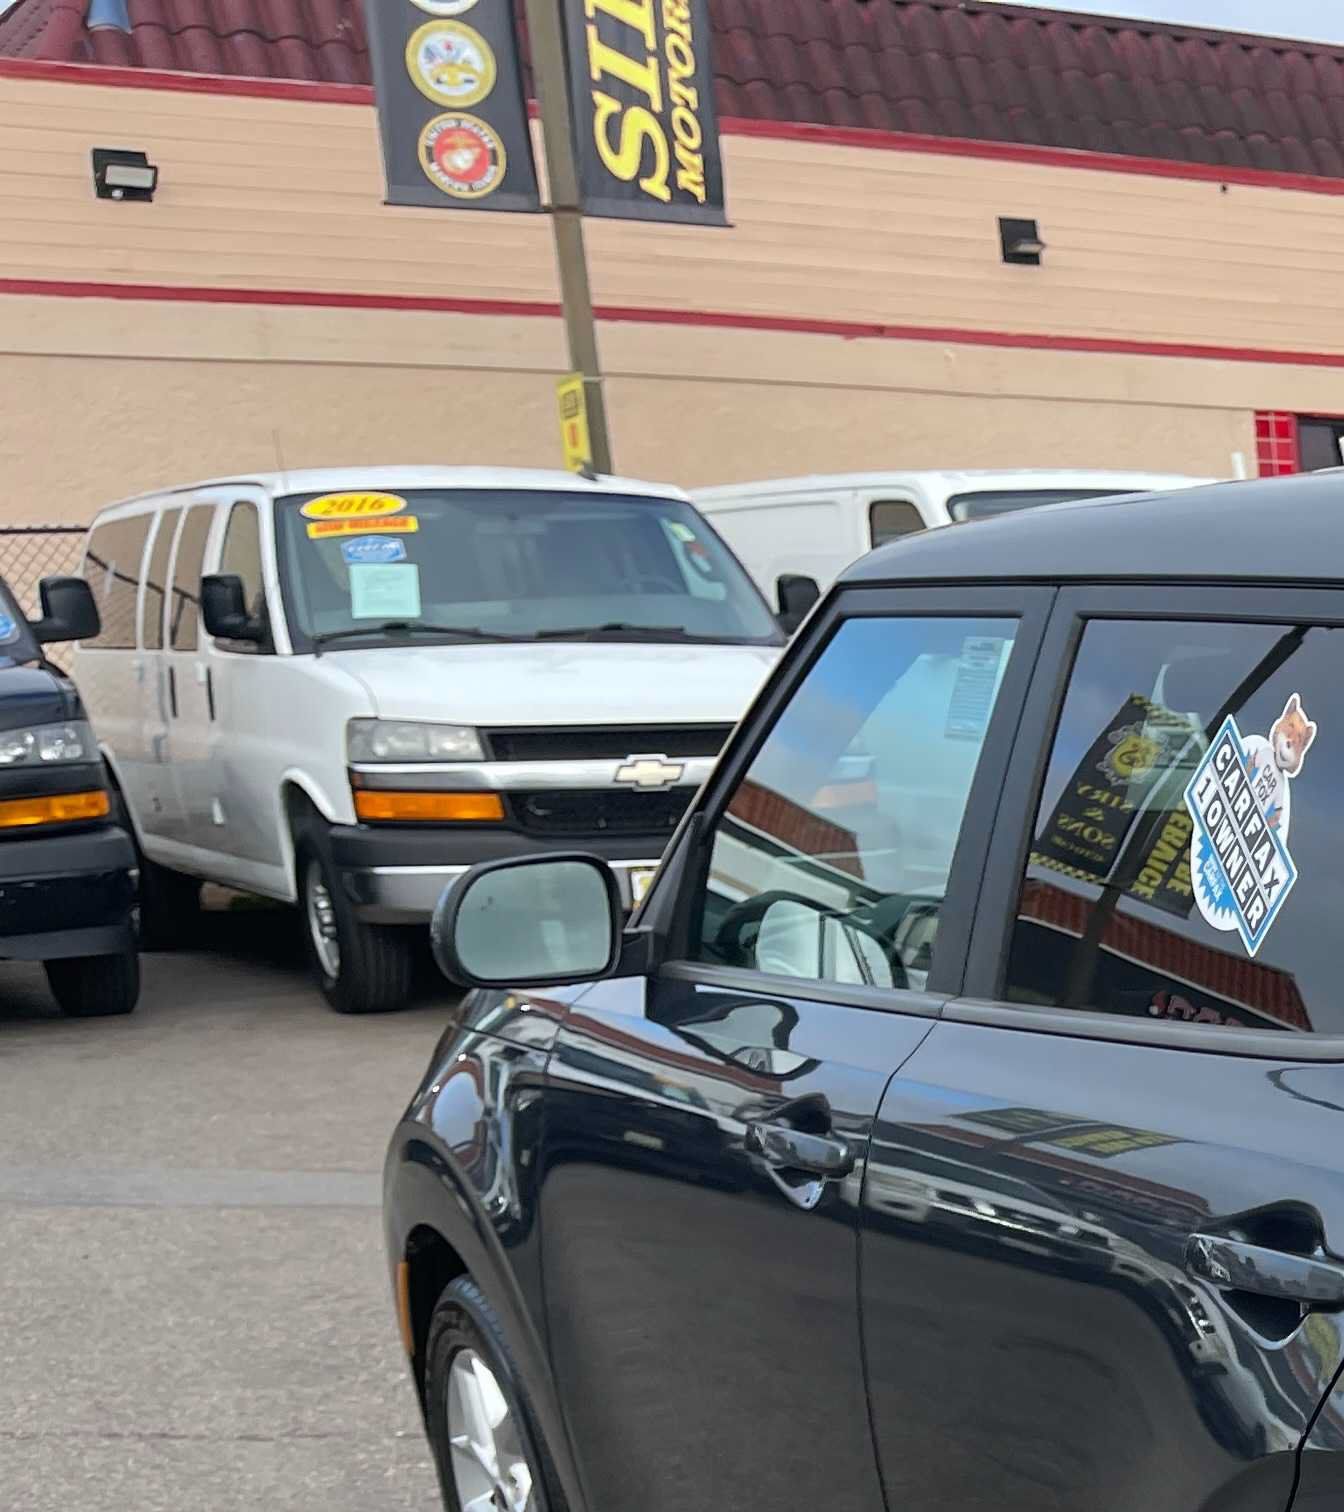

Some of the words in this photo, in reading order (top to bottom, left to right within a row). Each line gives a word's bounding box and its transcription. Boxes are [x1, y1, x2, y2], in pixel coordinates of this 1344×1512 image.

[584, 0, 671, 202] SI
[321, 497, 387, 515] 2016
[1213, 743, 1282, 897] CARFAX
